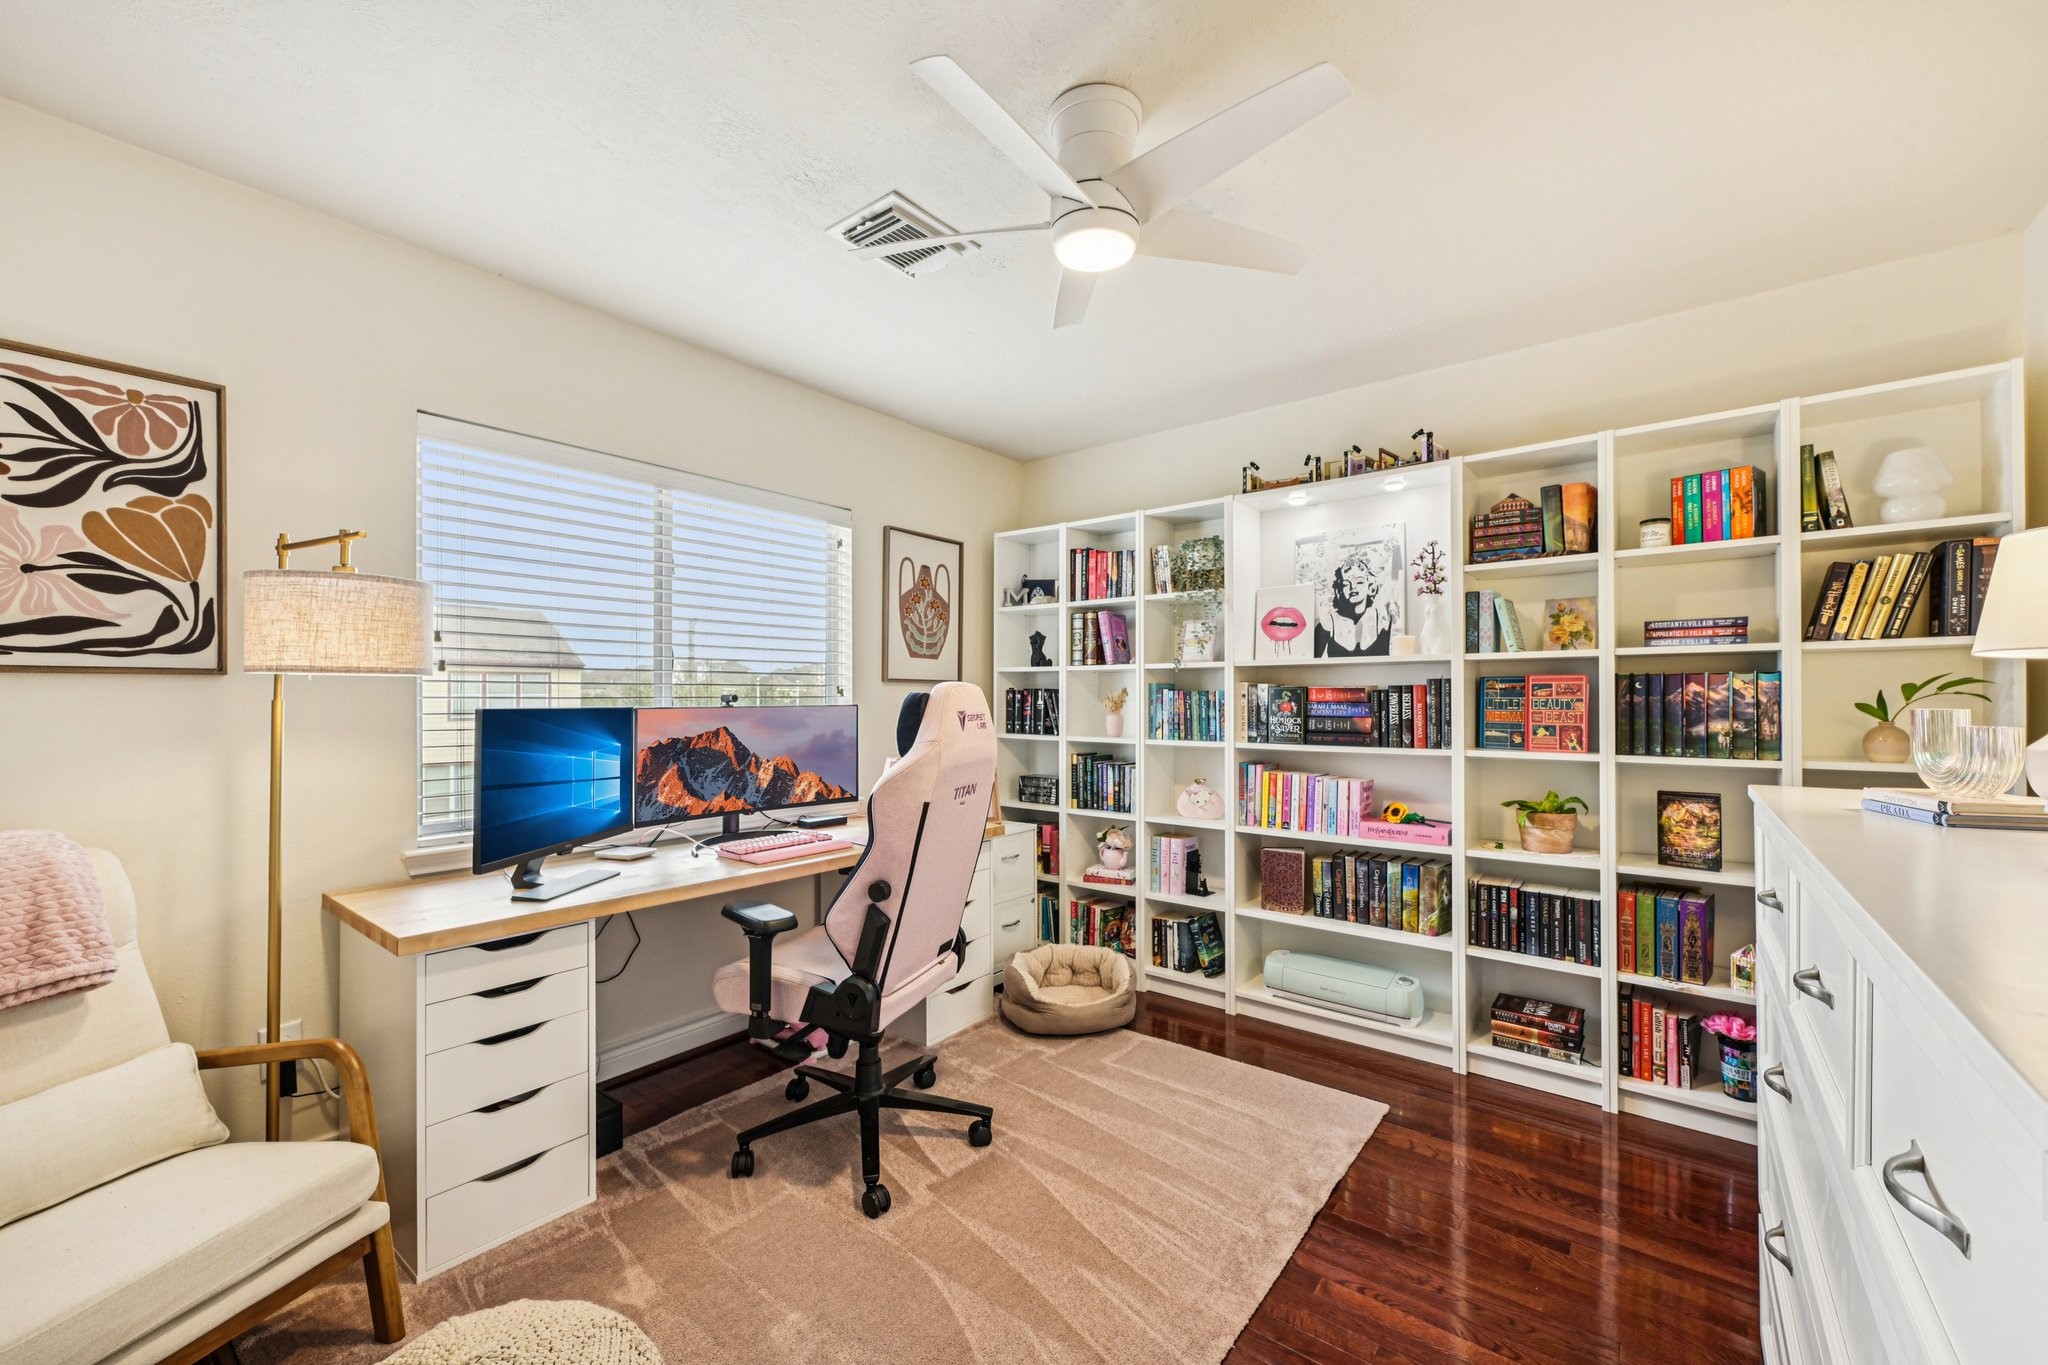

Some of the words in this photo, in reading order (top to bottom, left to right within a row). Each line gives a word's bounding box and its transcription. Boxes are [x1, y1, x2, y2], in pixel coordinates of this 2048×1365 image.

[1956, 548, 1965, 569] GAMES
[1004, 588, 1029, 607] M
[1651, 621, 1683, 629] ASSISTANT
[1688, 620, 1713, 628] VILLAIN
[1686, 637, 1710, 645] VILLAIN
[1389, 692, 1399, 724] POWERLESS
[1403, 693, 1411, 720] RECKLESS
[1487, 699, 1519, 709] LITTLE
[1532, 699, 1577, 710] BEAUTY
[1270, 715, 1302, 725] HEMLOCK
[1487, 711, 1525, 722] MERMAI
[1545, 712, 1583, 723] BEAST
[977, 722, 987, 730] LAB
[1275, 723, 1303, 734] SILVER
[954, 783, 978, 800] TITAN
[1880, 804, 1911, 818] PRADA
[1661, 846, 1714, 859] SPELLSHOP
[1495, 1010, 1518, 1019] REBECCA
[1544, 1021, 1566, 1031] FOURTH
[1654, 1012, 1663, 1034] Cultish
[1547, 1052, 1566, 1061] STORM
[1549, 1047, 1564, 1056] ONYX
